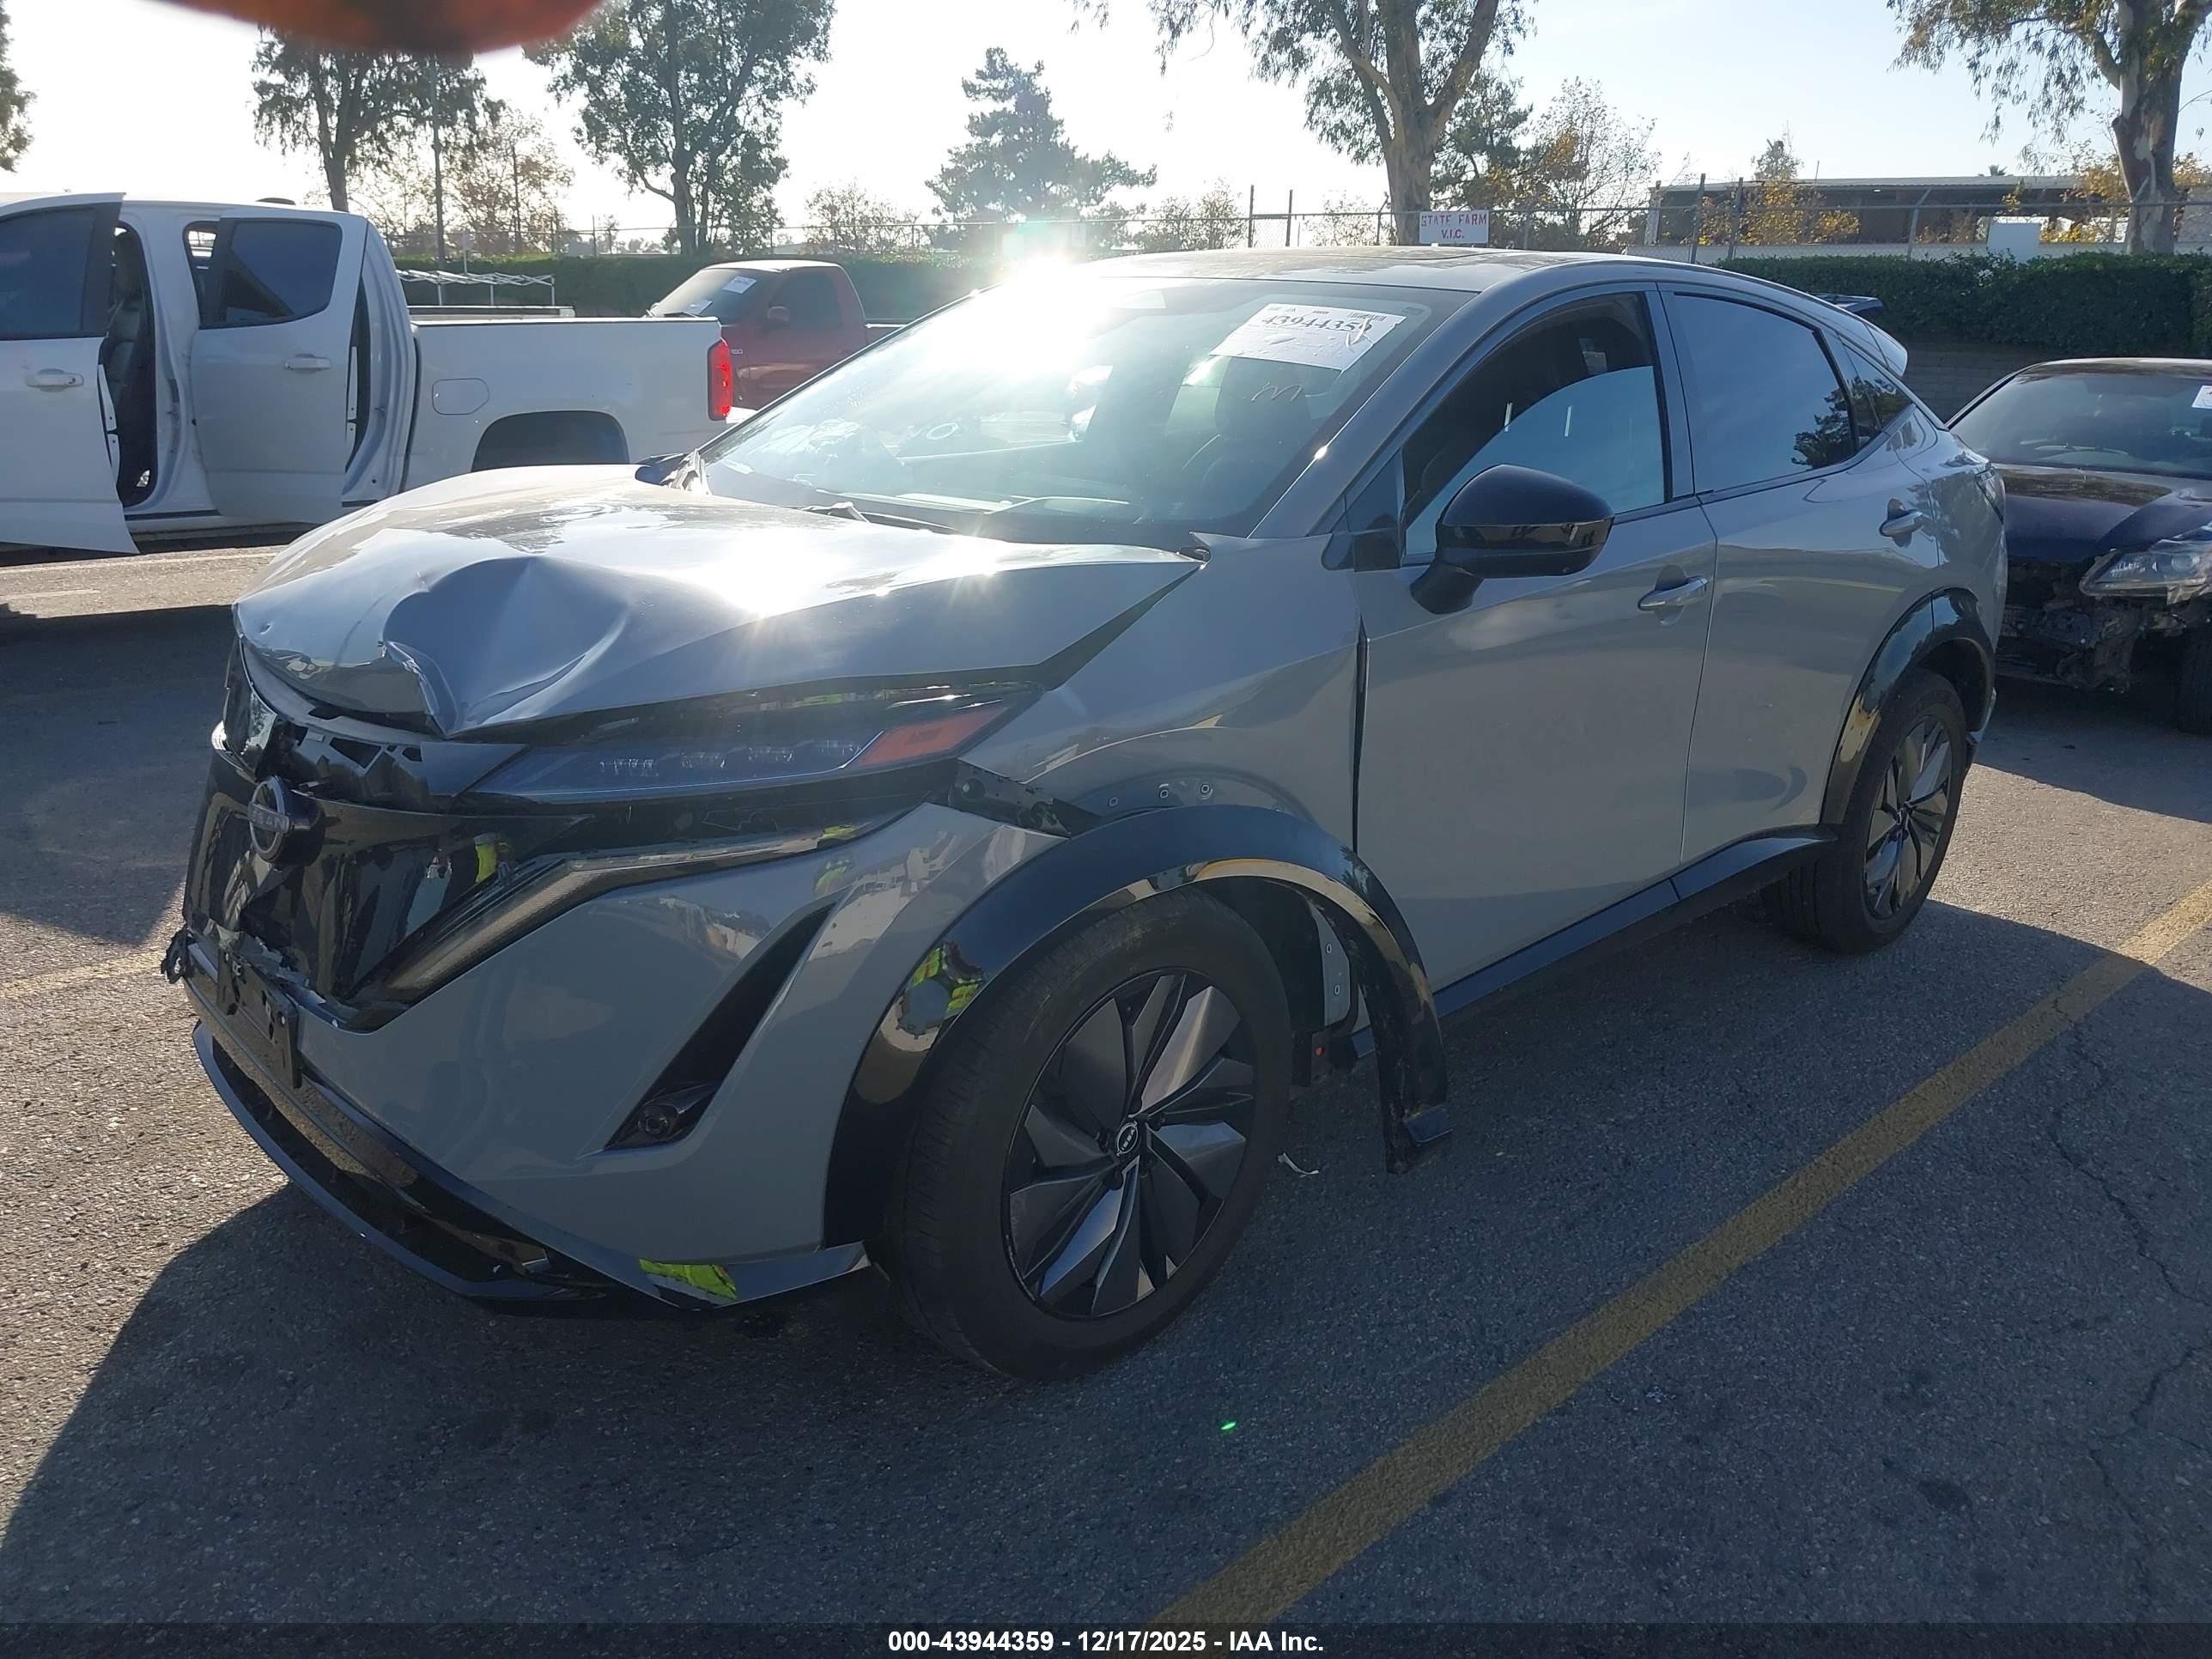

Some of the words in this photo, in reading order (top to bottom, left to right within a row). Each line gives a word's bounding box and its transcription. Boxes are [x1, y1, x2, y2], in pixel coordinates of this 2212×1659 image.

[1421, 215, 1451, 228] STATE
[1459, 214, 1487, 226] FARM
[1441, 228, 1465, 240] V.I.C.
